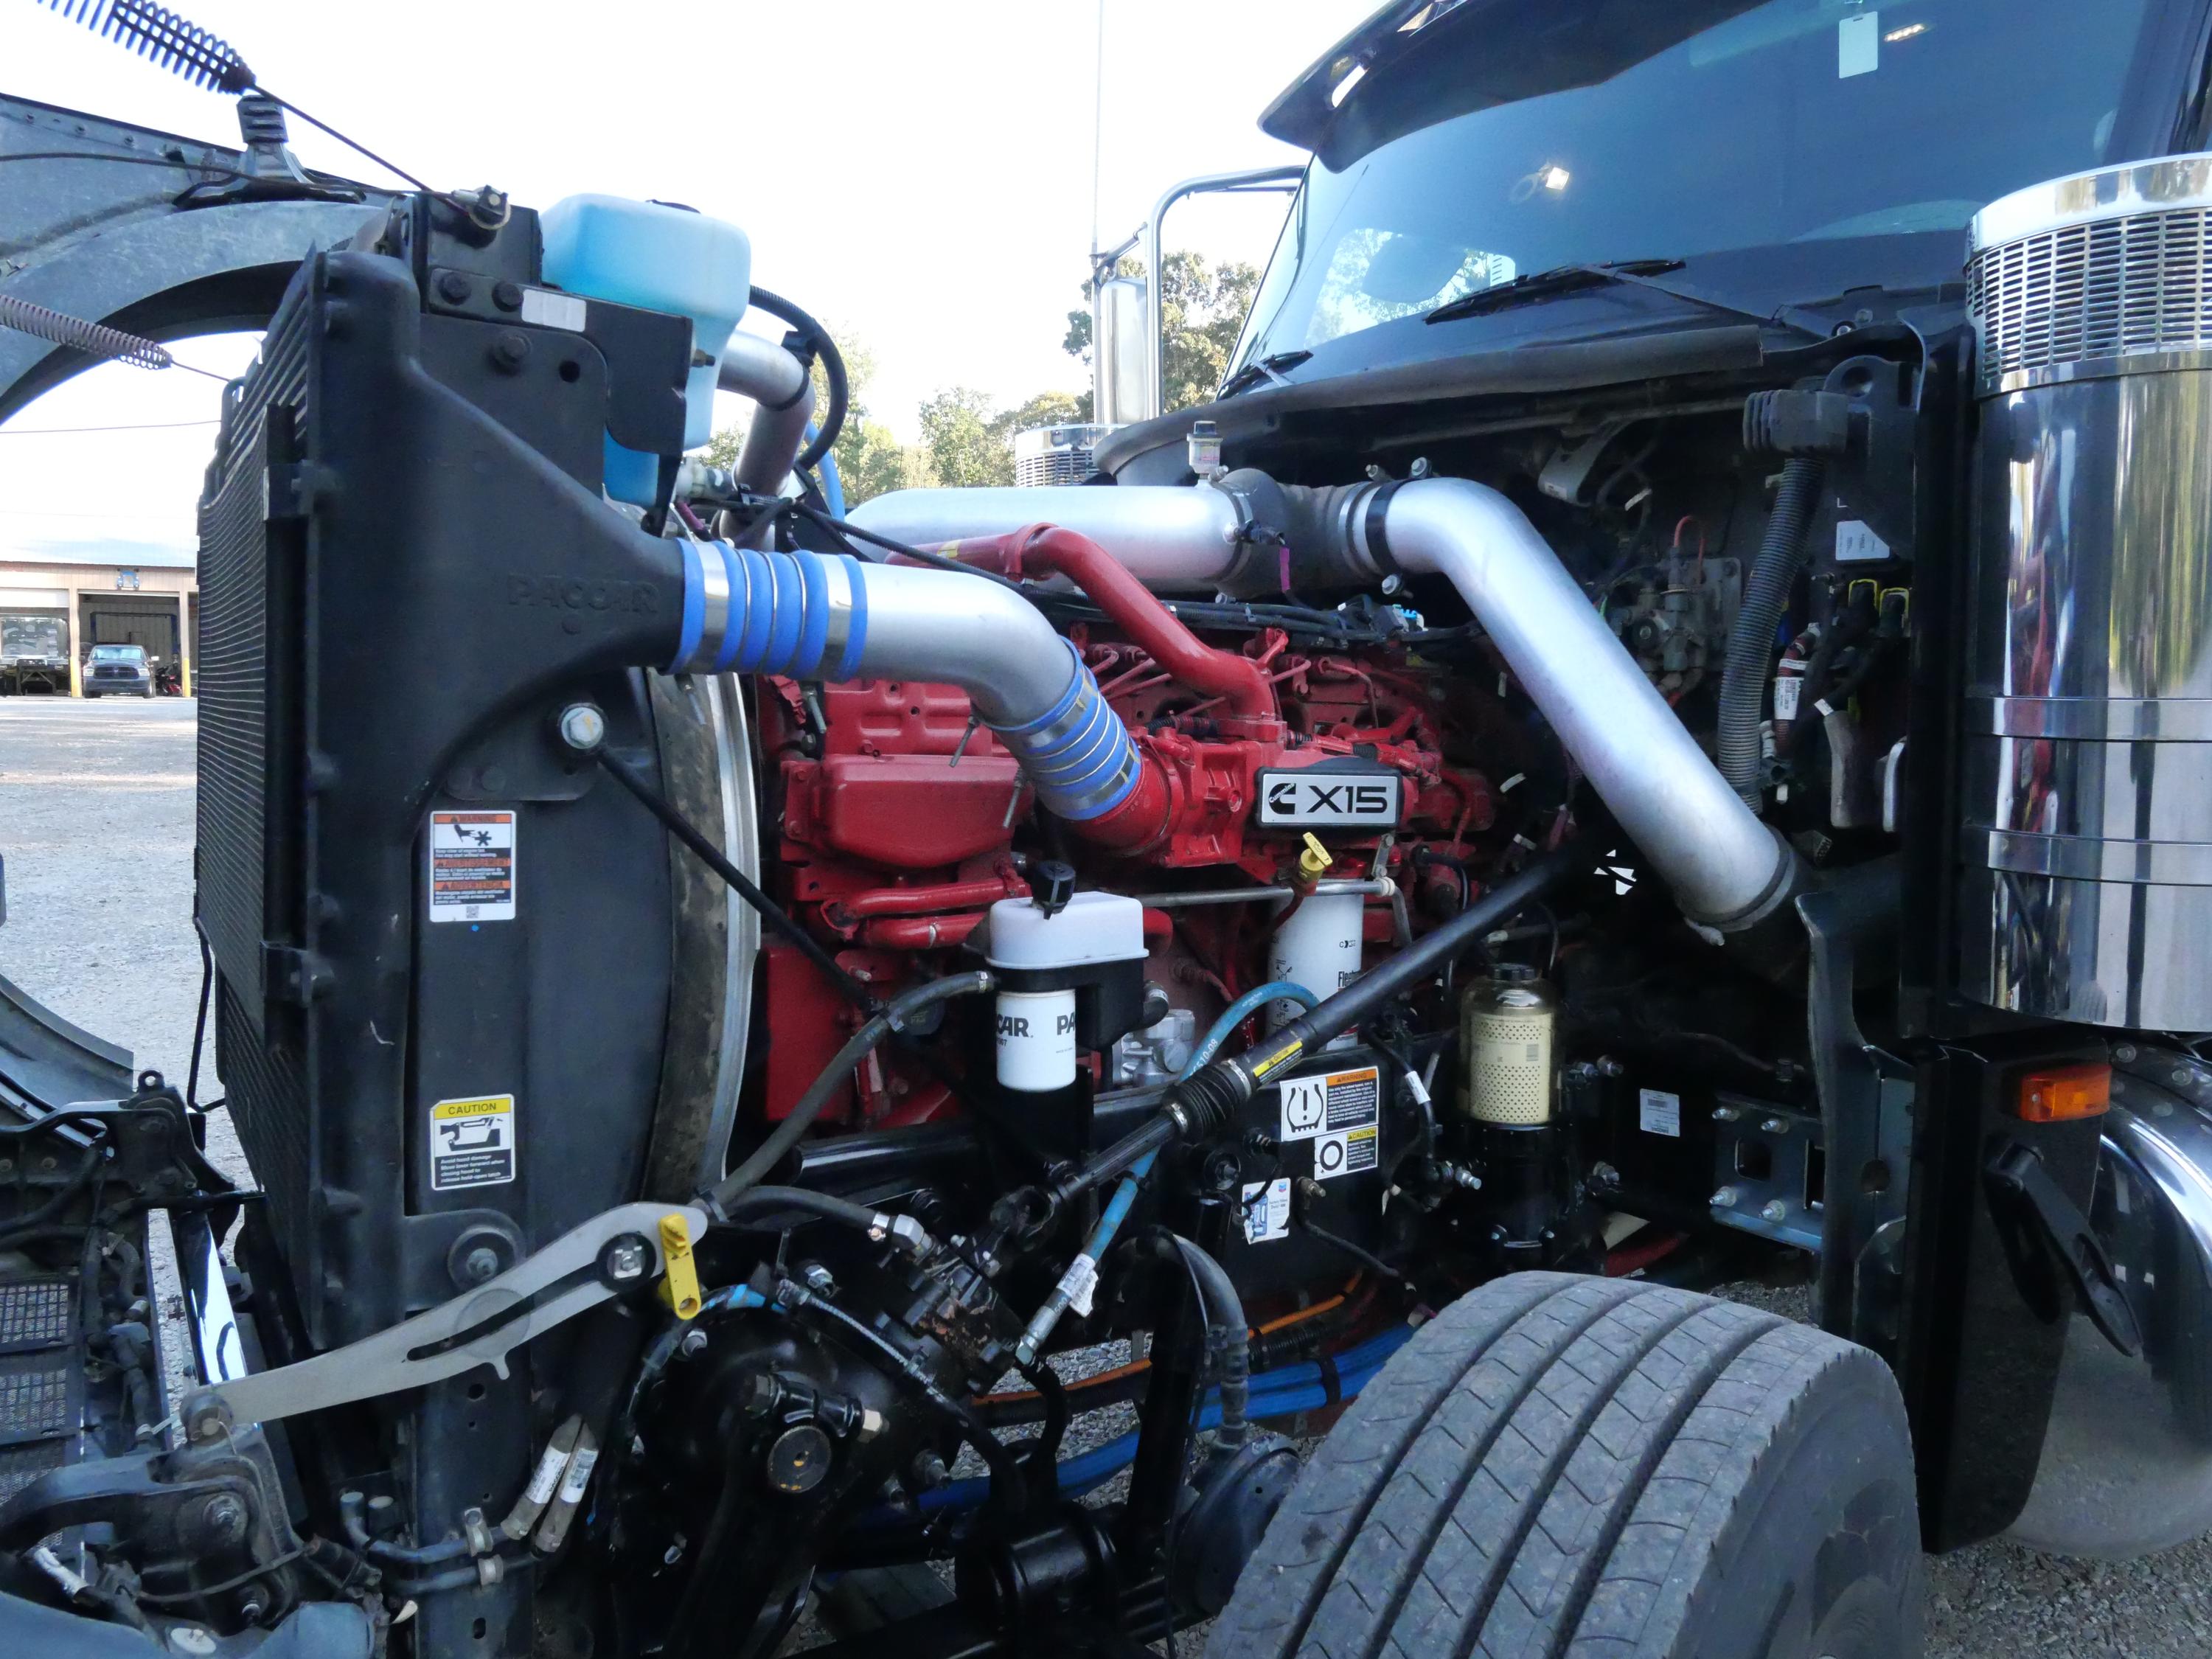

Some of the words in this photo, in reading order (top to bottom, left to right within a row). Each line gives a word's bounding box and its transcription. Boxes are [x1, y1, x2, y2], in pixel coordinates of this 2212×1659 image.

[1269, 783, 1295, 803] Cummins
[1306, 785, 1388, 813] X15
[1341, 1072, 1366, 1082] WARNING
[448, 1102, 496, 1115] CAUTION
[1352, 1129, 1376, 1138] CAUTION
